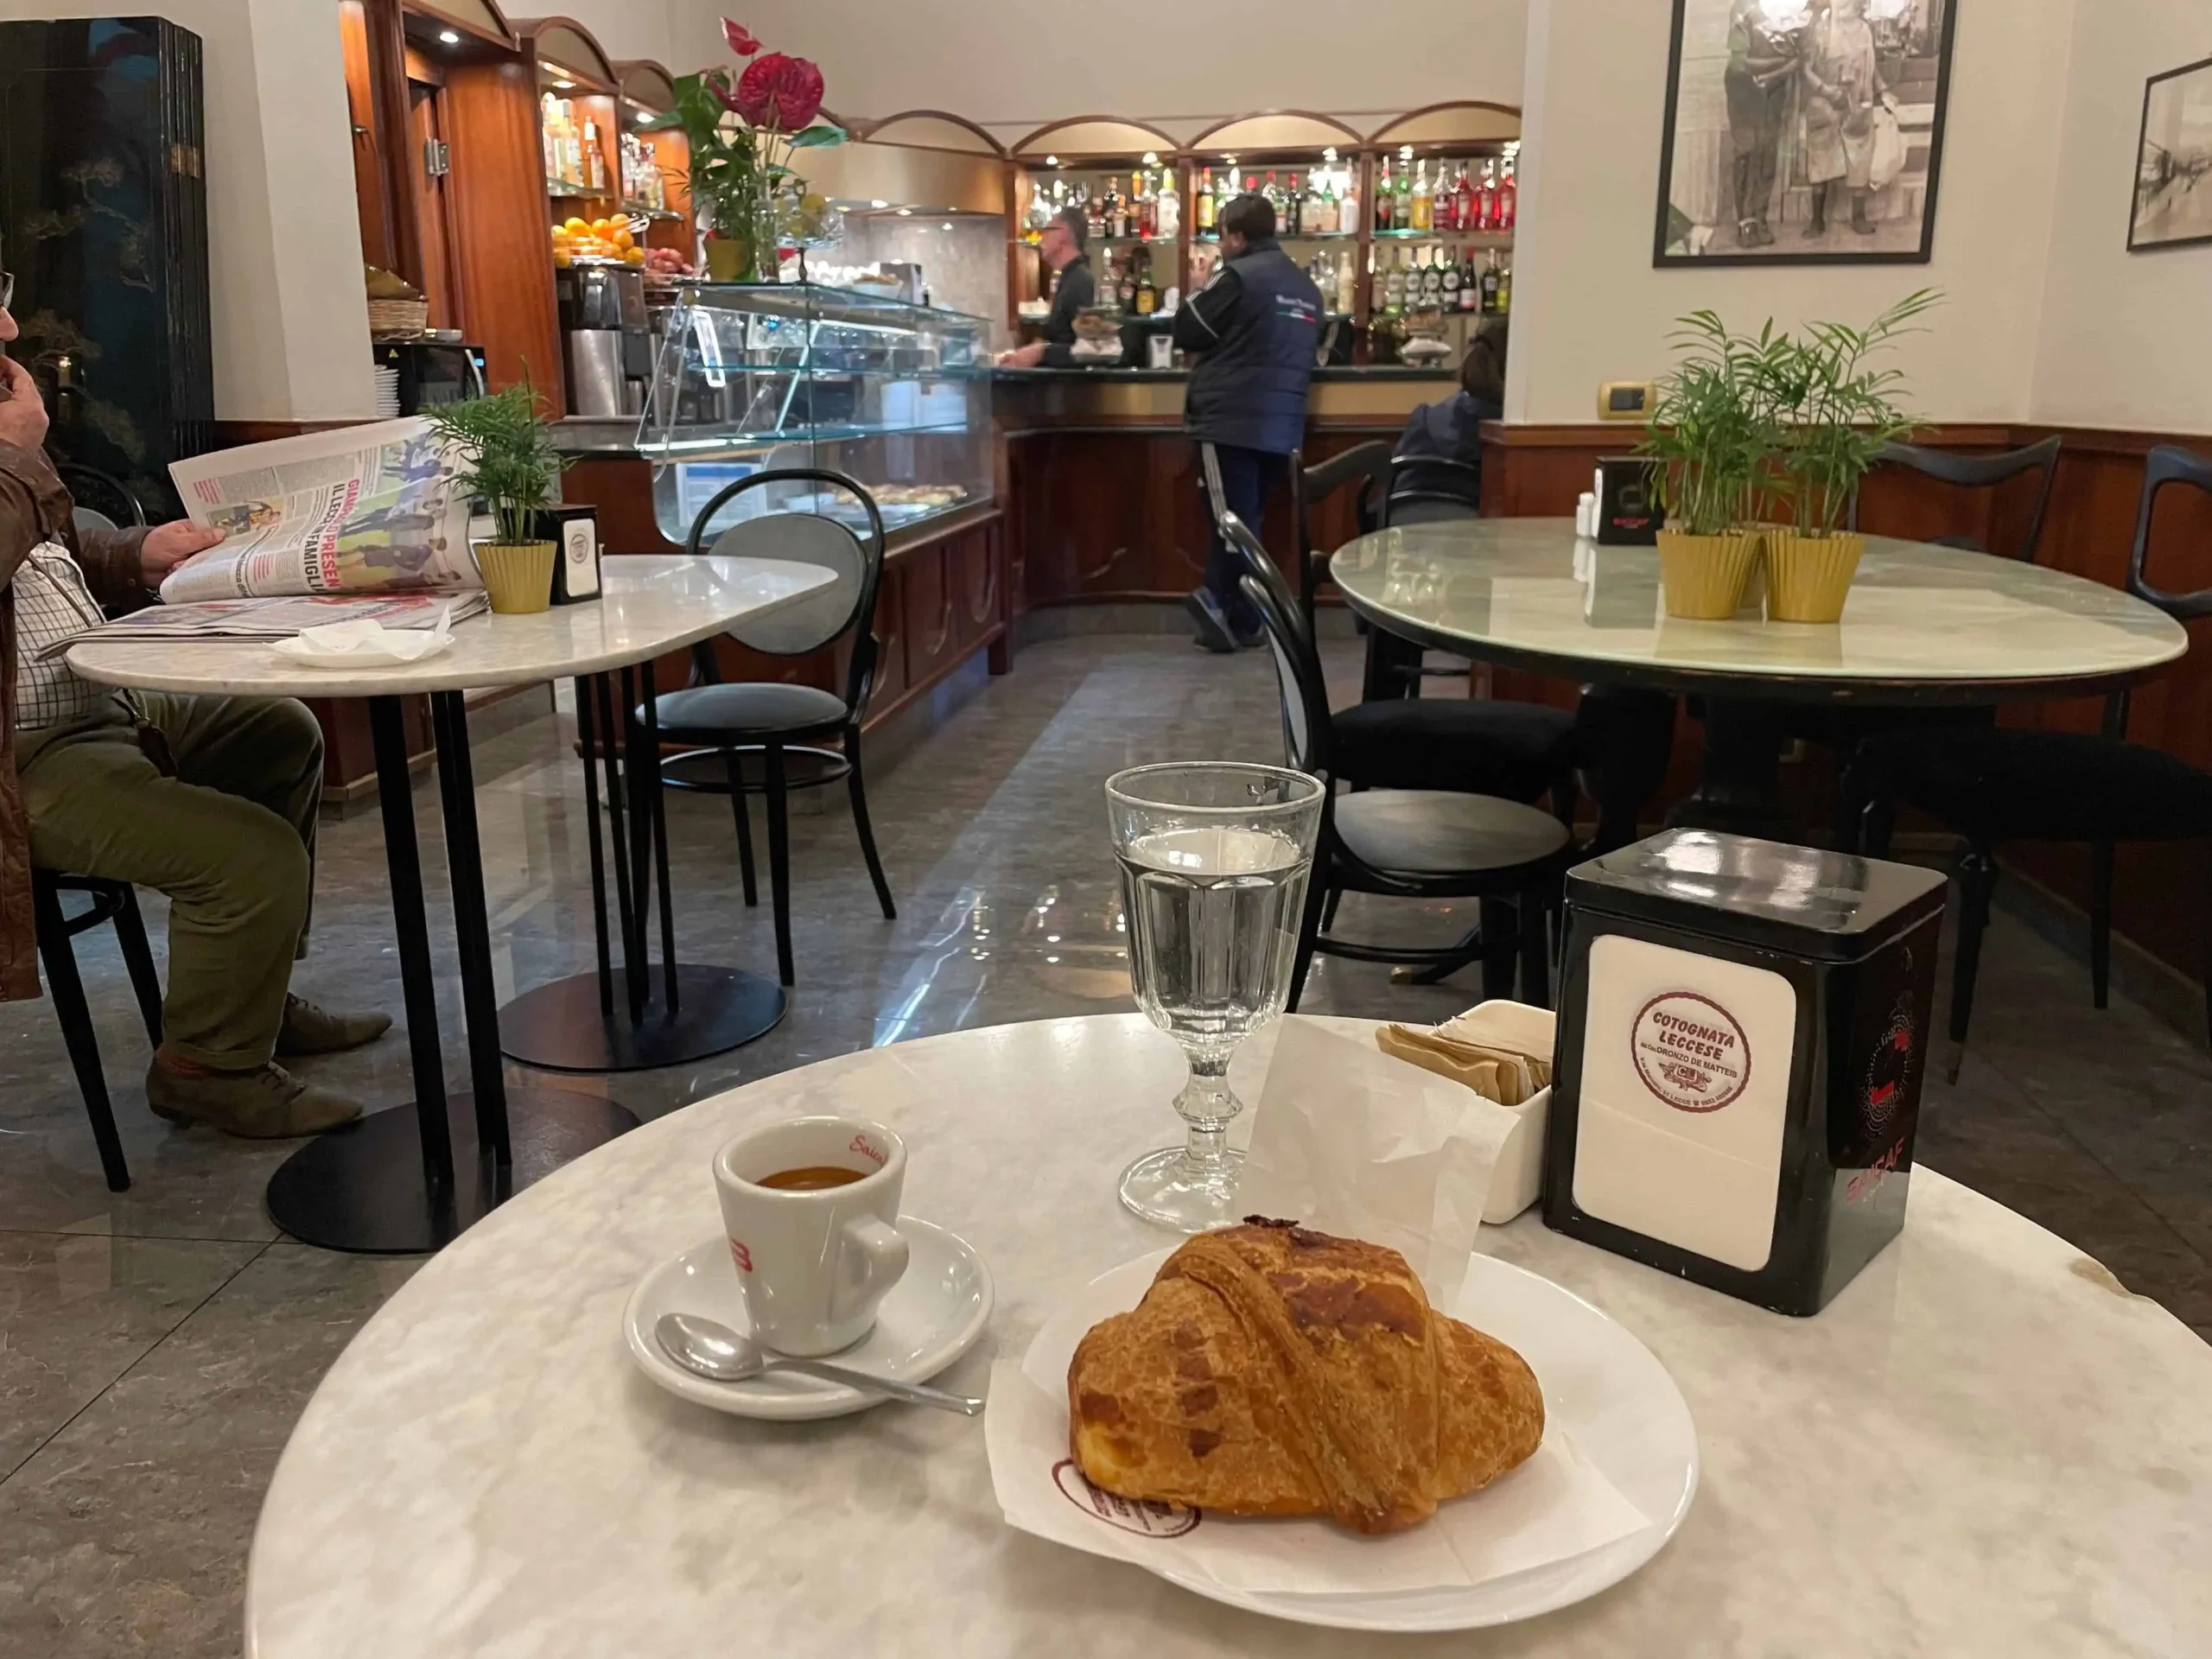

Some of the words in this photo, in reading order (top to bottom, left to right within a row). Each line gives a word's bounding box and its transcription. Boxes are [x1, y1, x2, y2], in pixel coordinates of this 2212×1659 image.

[333, 484, 346, 497] IL
[1653, 1012, 1735, 1048] COTOGNATA
[1659, 1030, 1724, 1060] LECCESE
[1691, 1058, 1702, 1067] DE
[1703, 1061, 1738, 1078] MATTEIS
